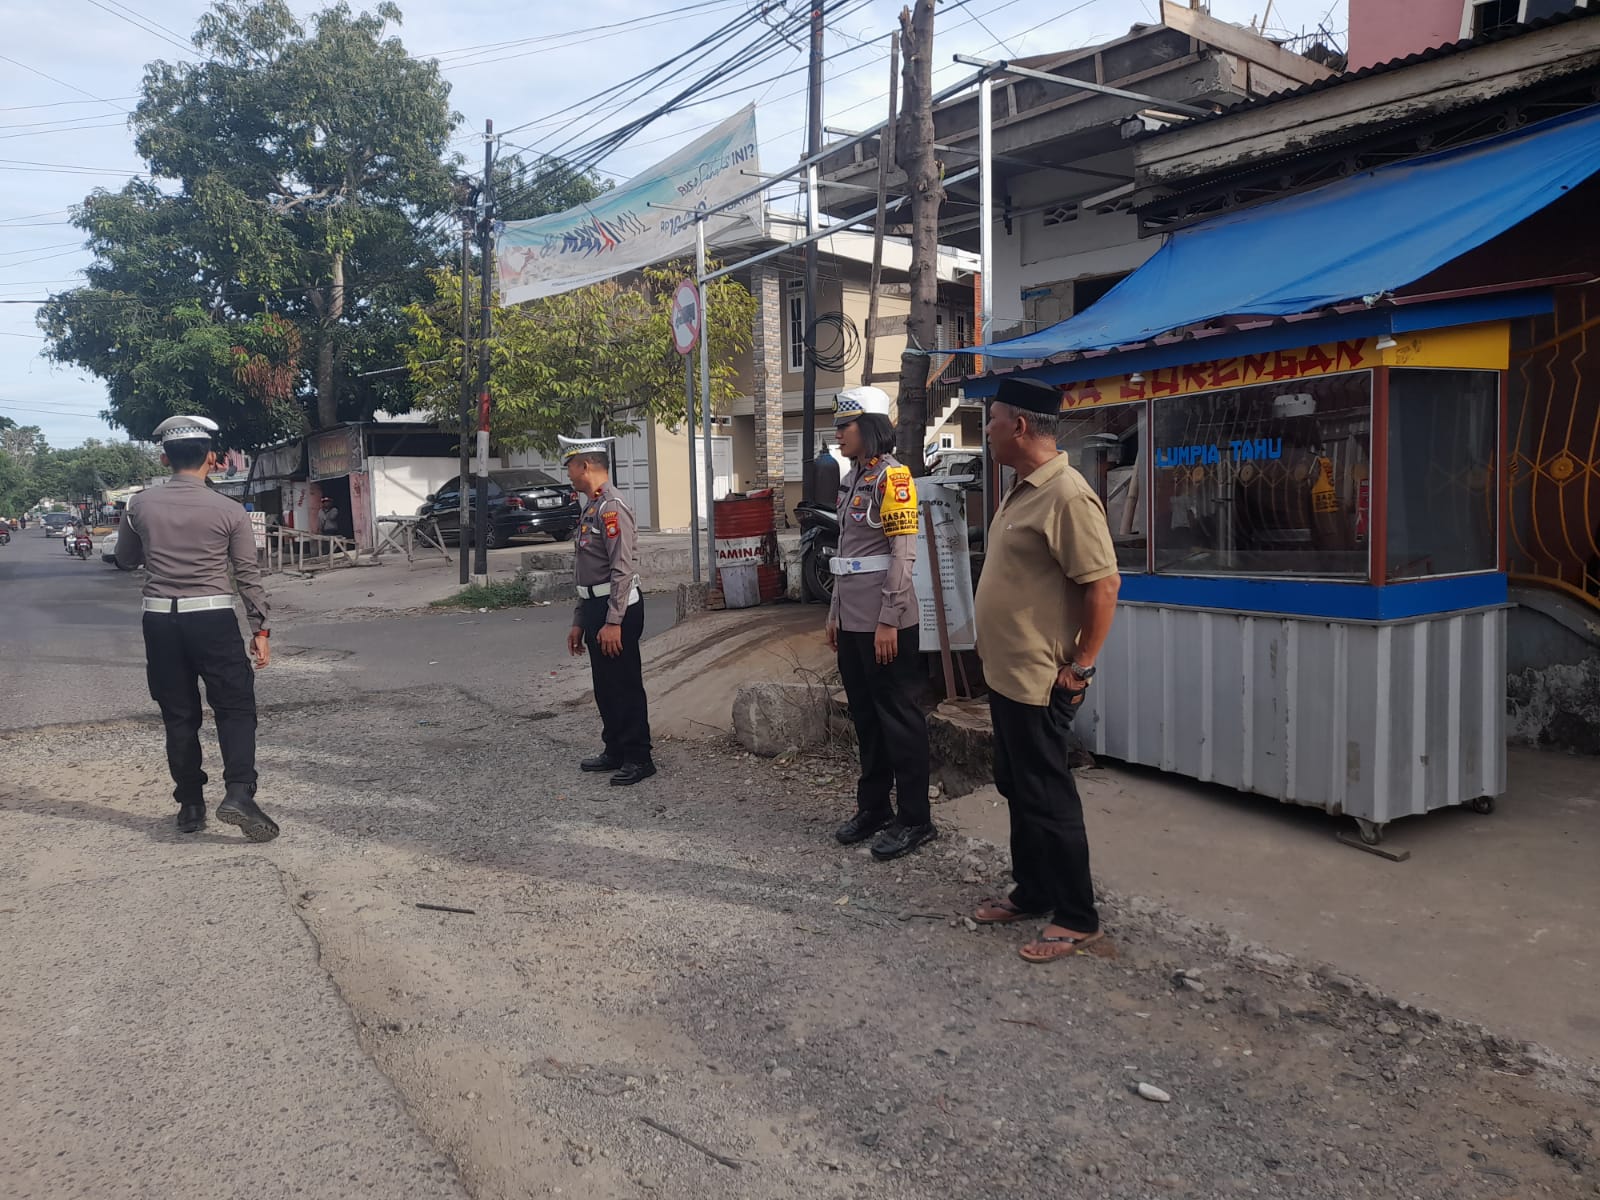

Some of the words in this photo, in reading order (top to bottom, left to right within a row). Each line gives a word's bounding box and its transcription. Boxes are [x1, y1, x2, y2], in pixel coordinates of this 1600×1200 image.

[731, 143, 754, 166] INI?
[1156, 443, 1219, 468] LUMPIA
[1230, 437, 1281, 461] TAHU
